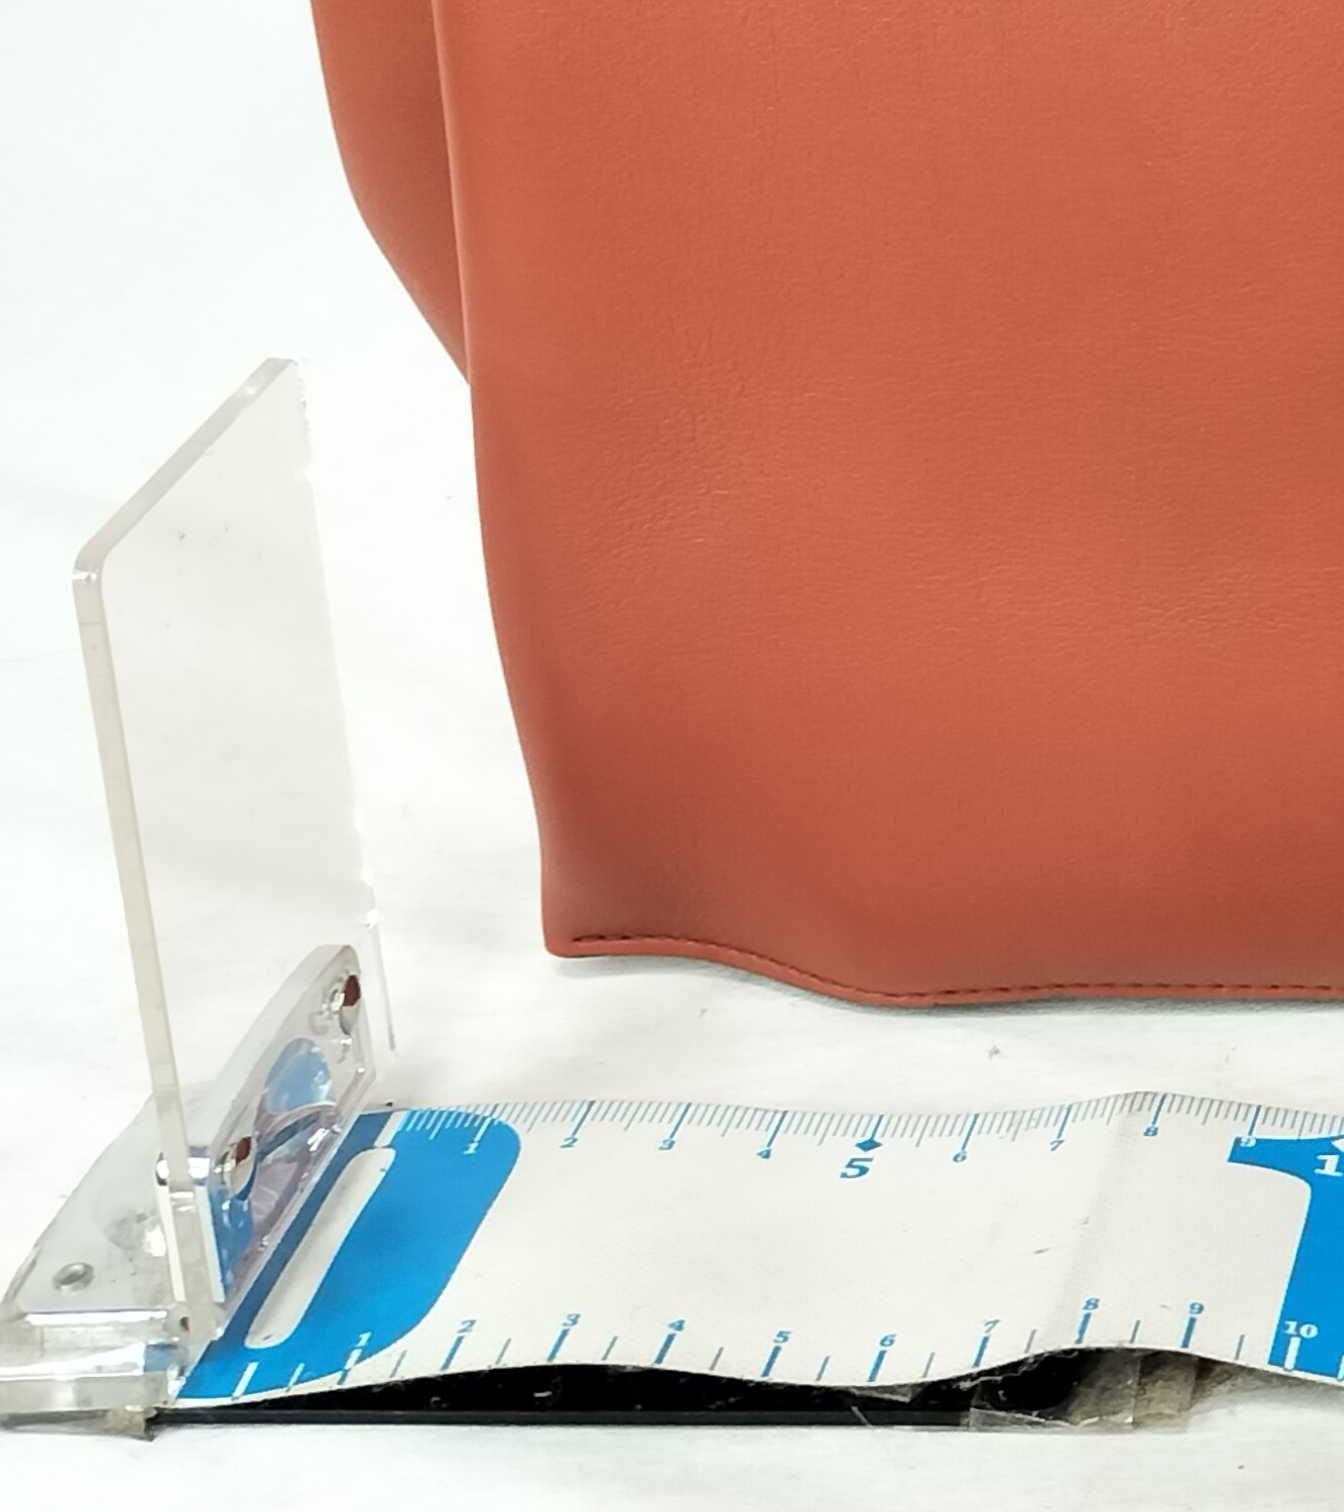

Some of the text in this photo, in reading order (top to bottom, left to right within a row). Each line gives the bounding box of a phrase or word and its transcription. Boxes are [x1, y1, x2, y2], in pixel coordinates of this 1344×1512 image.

[462, 1141, 479, 1155] 1
[561, 1137, 577, 1148] 2
[659, 1138, 676, 1150] 3
[757, 1148, 772, 1159] 4
[840, 1158, 873, 1178] 5
[952, 1150, 968, 1162] 6
[1050, 1140, 1065, 1151] 7
[1143, 1124, 1160, 1137] 8
[1238, 1135, 1257, 1147] 9
[355, 1332, 371, 1346] 1
[458, 1319, 476, 1333] 2
[562, 1314, 581, 1326] 3
[667, 1319, 685, 1332] 4
[772, 1331, 791, 1344] 5
[879, 1334, 896, 1347] 6
[984, 1319, 1000, 1333] 7
[1082, 1298, 1099, 1311] 8
[1189, 1303, 1204, 1316] 9
[1284, 1321, 1318, 1337] 10
